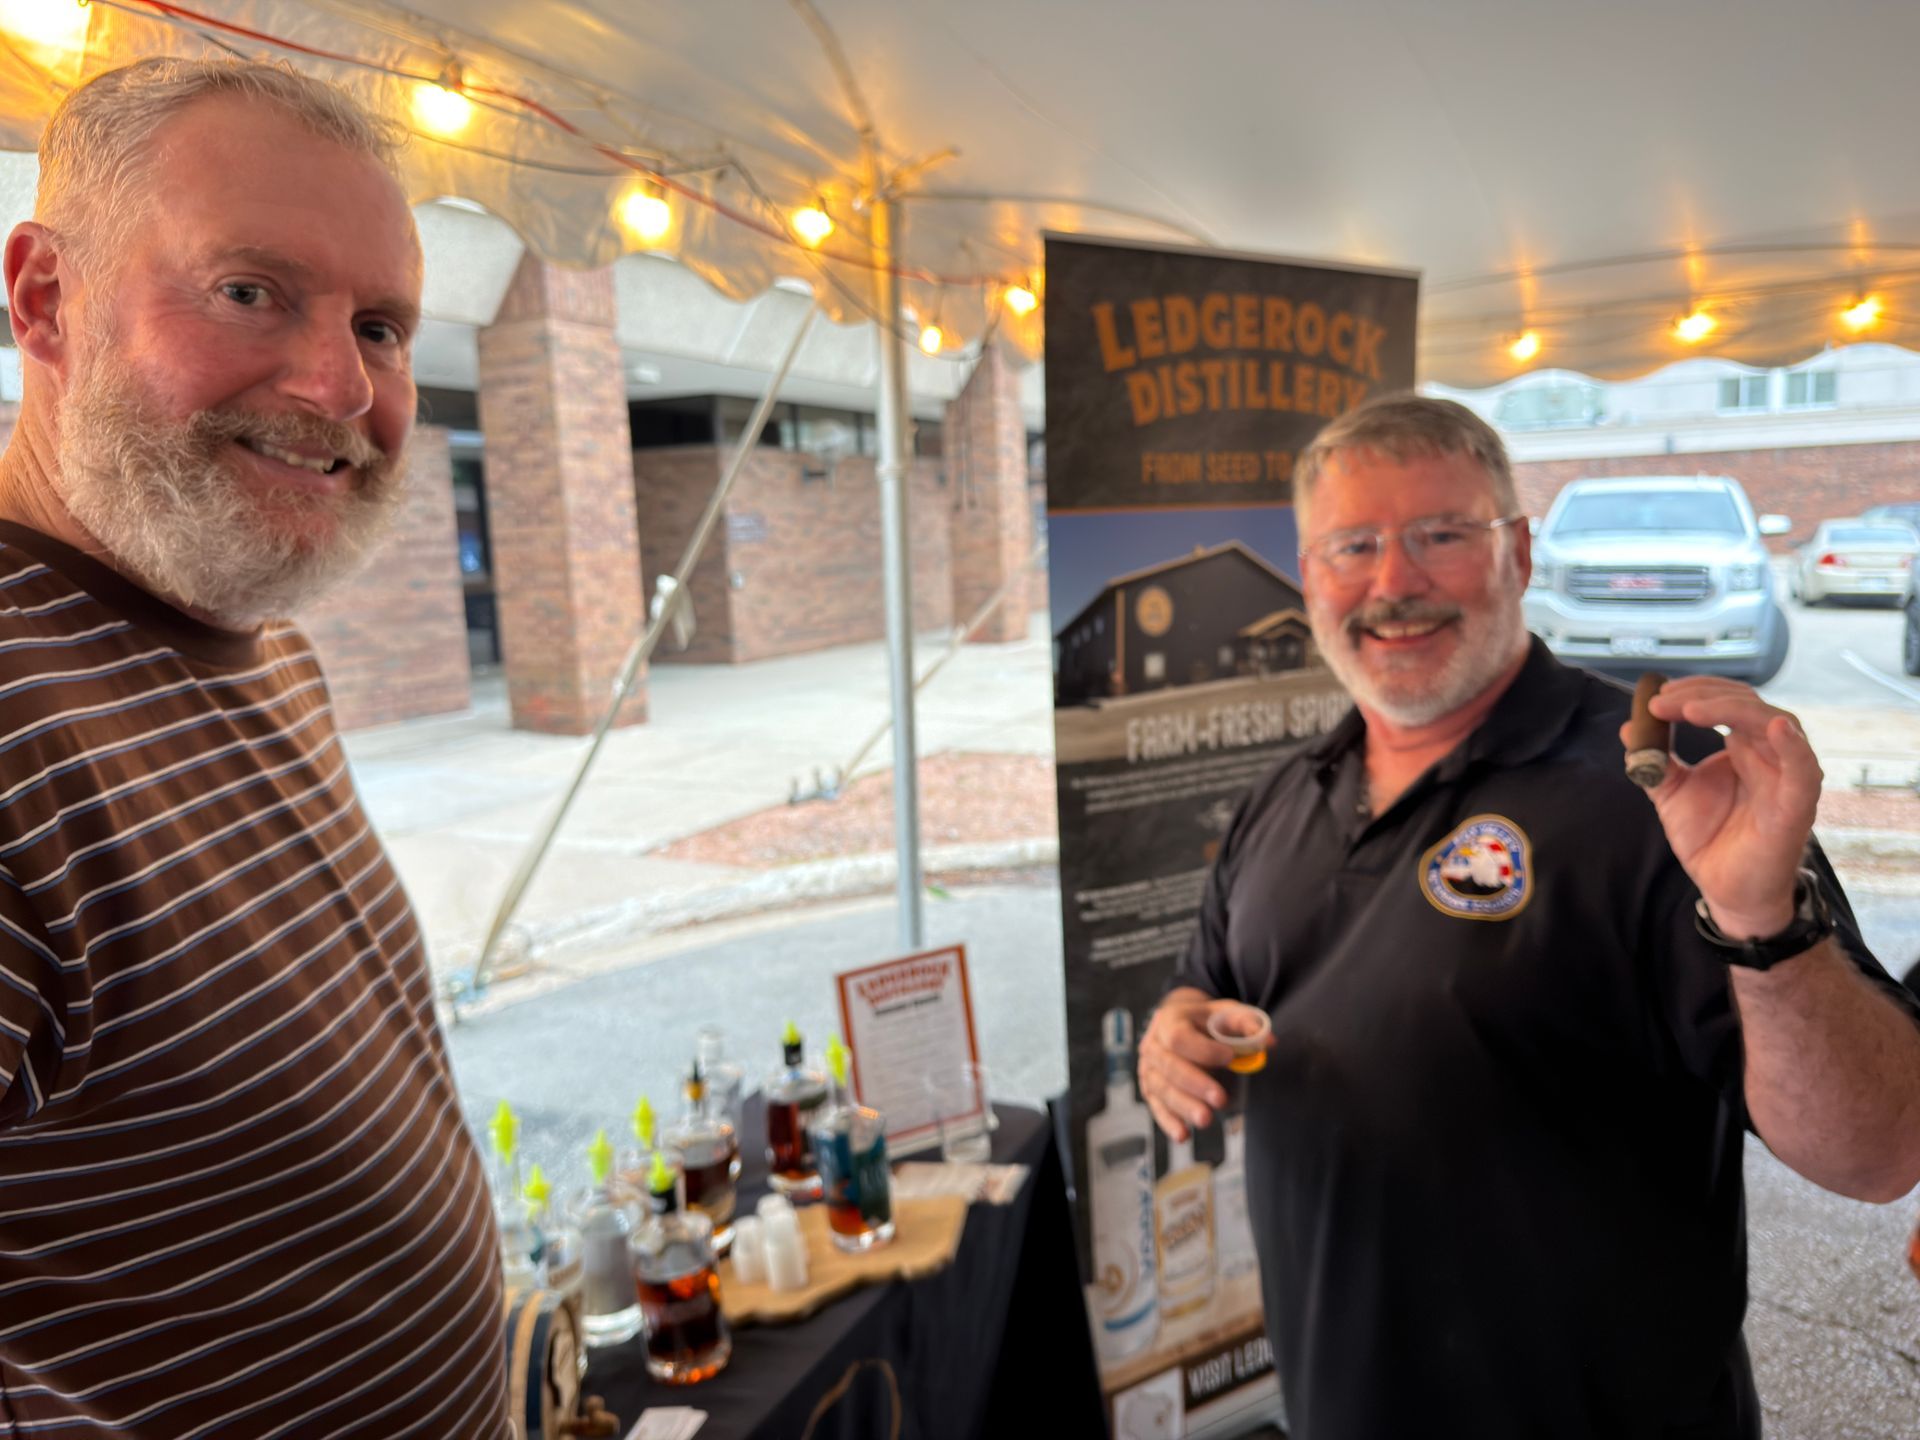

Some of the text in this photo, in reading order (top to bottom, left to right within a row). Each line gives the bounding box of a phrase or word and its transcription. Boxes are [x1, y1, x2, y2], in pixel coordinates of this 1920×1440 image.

[1092, 292, 1386, 381] LEDGEROCK
[1125, 359, 1369, 427] DISTILLERY
[1141, 454, 1201, 484] FROM
[1206, 453, 1262, 483] SEED
